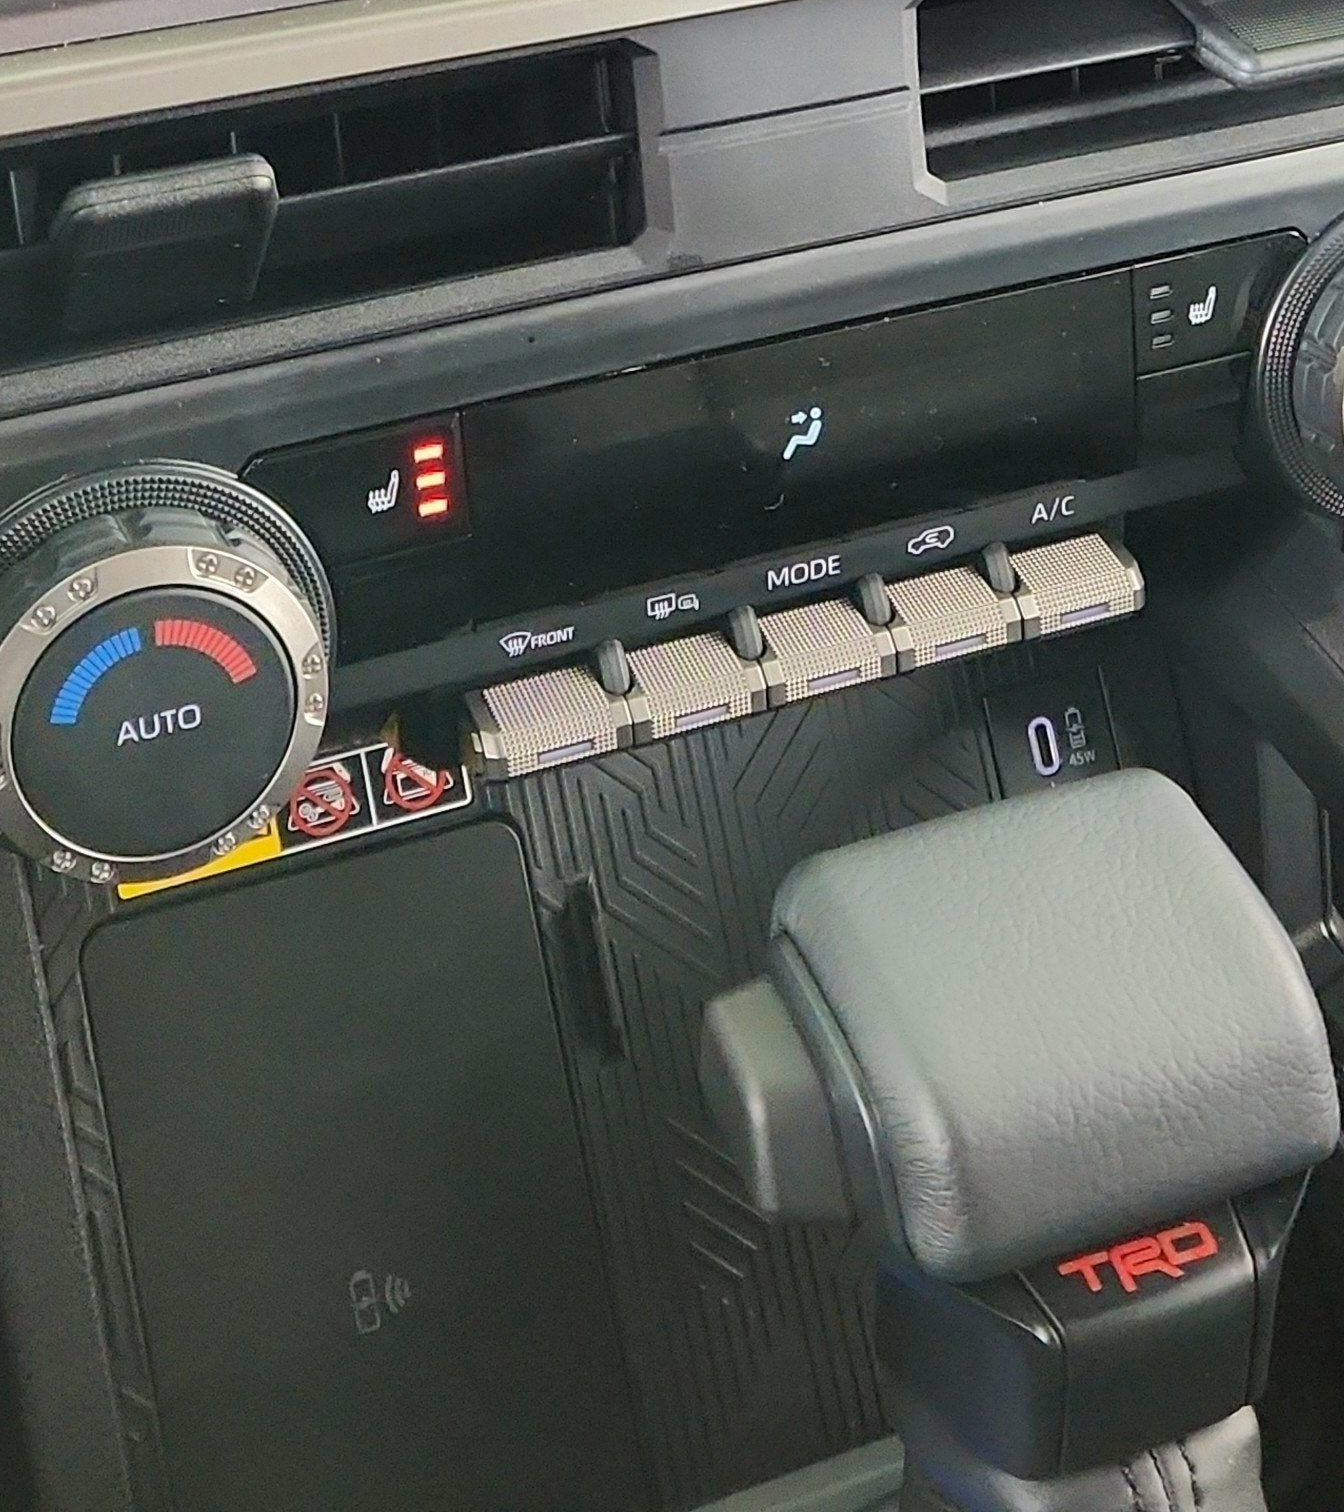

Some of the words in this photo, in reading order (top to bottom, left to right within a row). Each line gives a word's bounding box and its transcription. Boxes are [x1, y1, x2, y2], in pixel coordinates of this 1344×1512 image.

[1031, 494, 1076, 525] A/C
[766, 554, 841, 591] MODE
[530, 626, 575, 650] FRONT
[116, 702, 202, 747] AUTO
[1069, 749, 1096, 766] 45W
[1058, 1221, 1218, 1292] TRD
